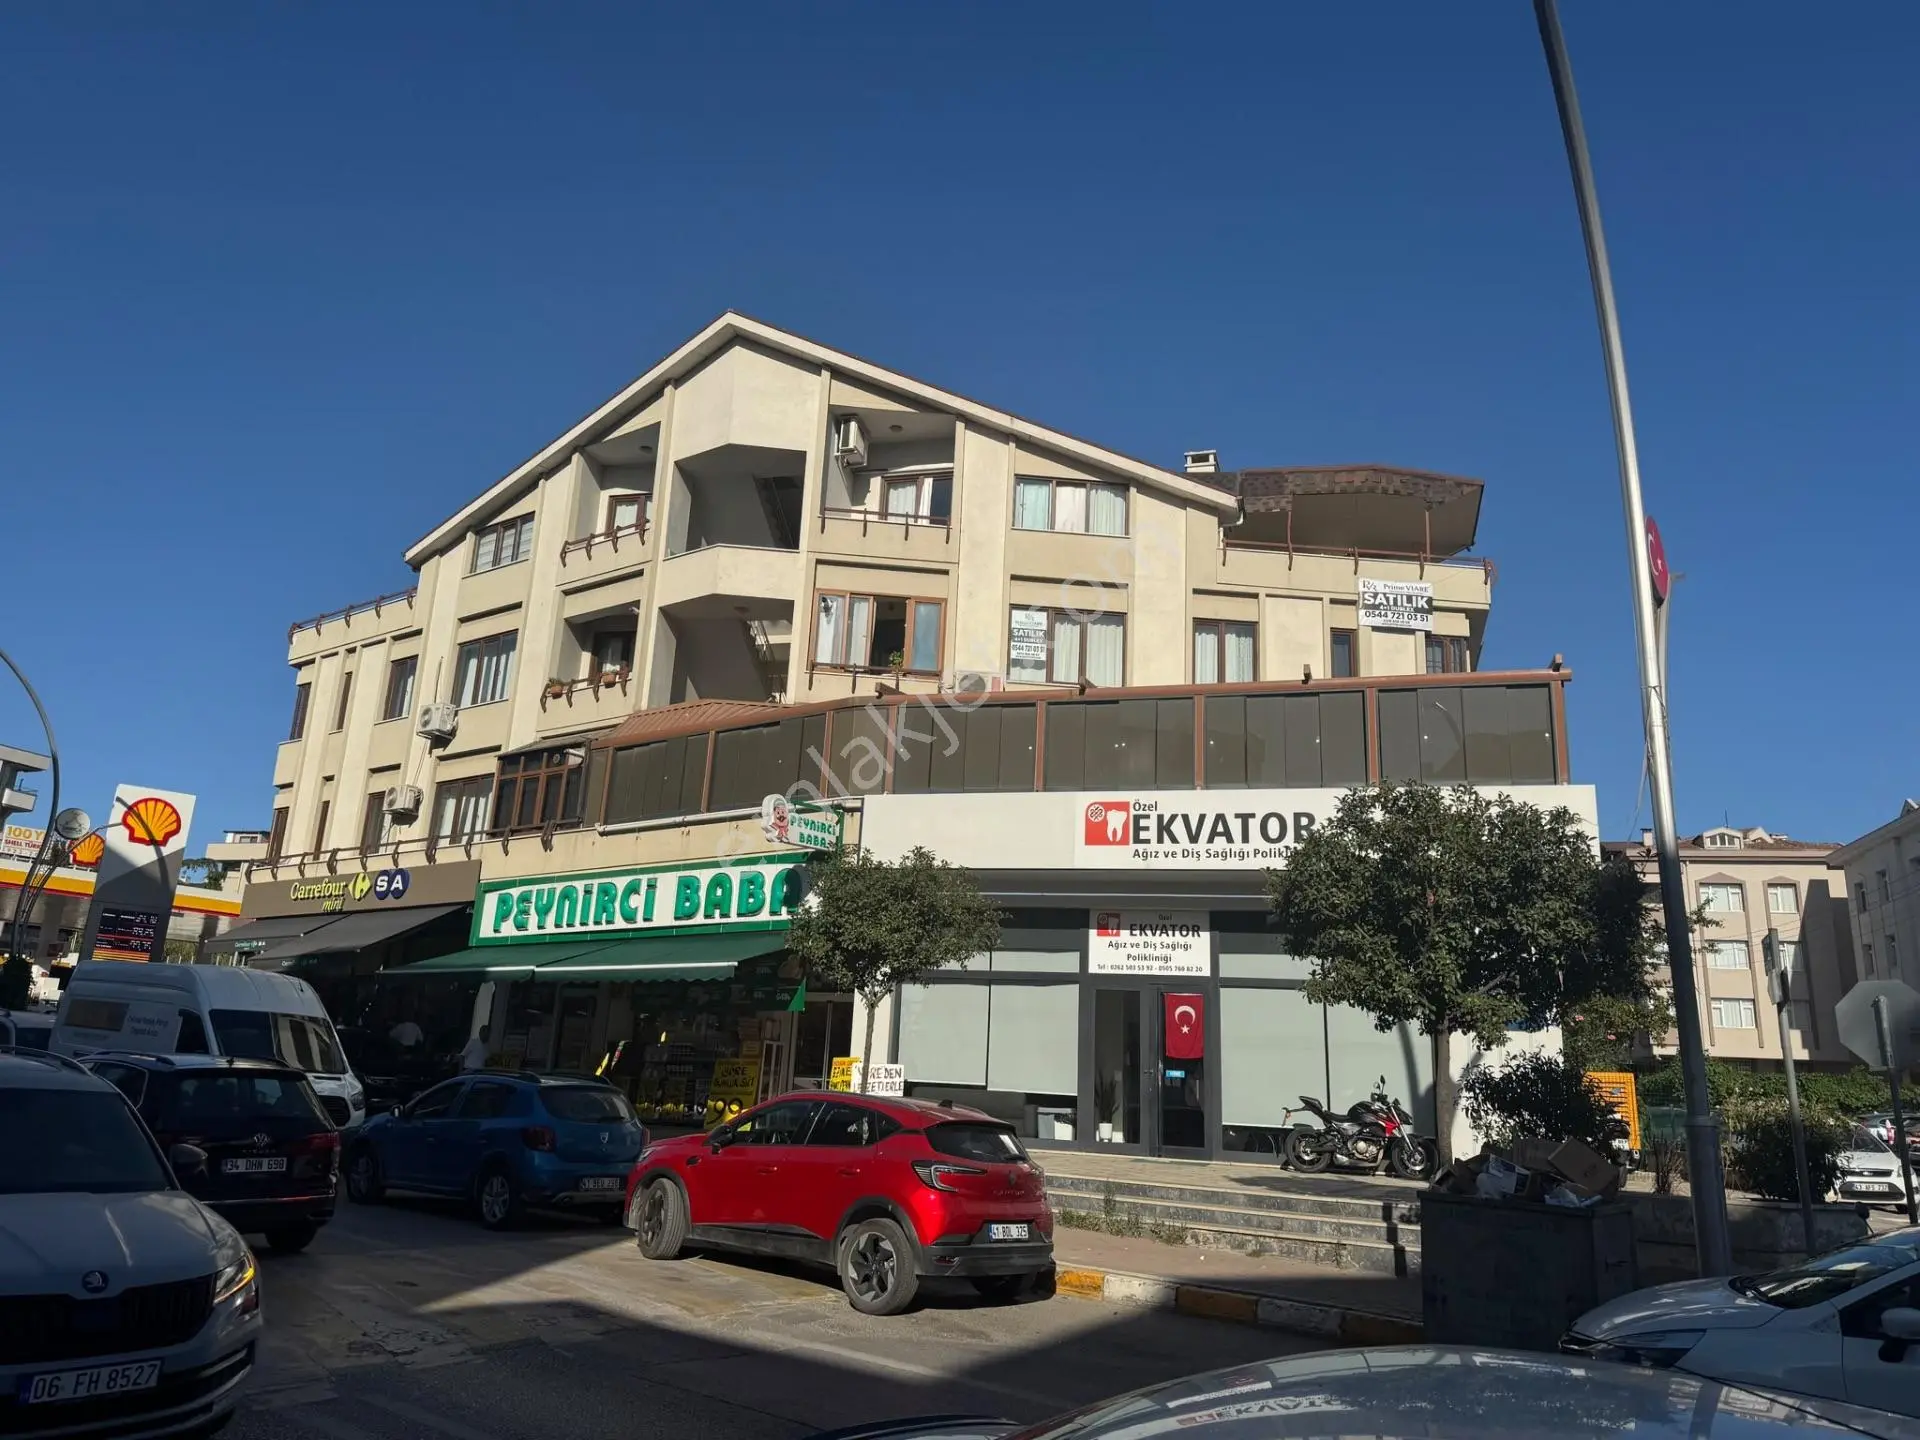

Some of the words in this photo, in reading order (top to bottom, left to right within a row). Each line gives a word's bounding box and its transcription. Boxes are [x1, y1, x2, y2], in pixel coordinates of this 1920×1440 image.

[1363, 592, 1429, 609] SATILIK
[1364, 610, 1389, 619] 0544
[1390, 611, 1405, 620] 721
[1406, 612, 1418, 622] 03
[1419, 614, 1429, 622] 51
[1132, 799, 1158, 812] Özel
[7, 826, 33, 839] 100
[1132, 812, 1316, 844] EKVATOR
[4, 839, 23, 847] SHELL
[799, 832, 829, 848] BABA
[1132, 848, 1160, 862] Ağız
[1163, 851, 1178, 859] ve
[1182, 848, 1201, 862] Diş
[1205, 848, 1251, 862] Sağlığı
[290, 878, 346, 900] Carrefour
[376, 875, 403, 892] SA
[674, 867, 802, 921] BABA
[322, 897, 345, 911] mini
[1129, 923, 1201, 938] EKVATOR
[1108, 940, 1127, 951] Ağız
[1143, 941, 1157, 952] Diş
[1160, 941, 1193, 952] Sağlığı
[1127, 953, 1172, 964] Polikliniği
[226, 1160, 240, 1171] 34
[34, 1376, 61, 1400] 06
[73, 1371, 101, 1396] FH
[106, 1363, 158, 1391] 8527
